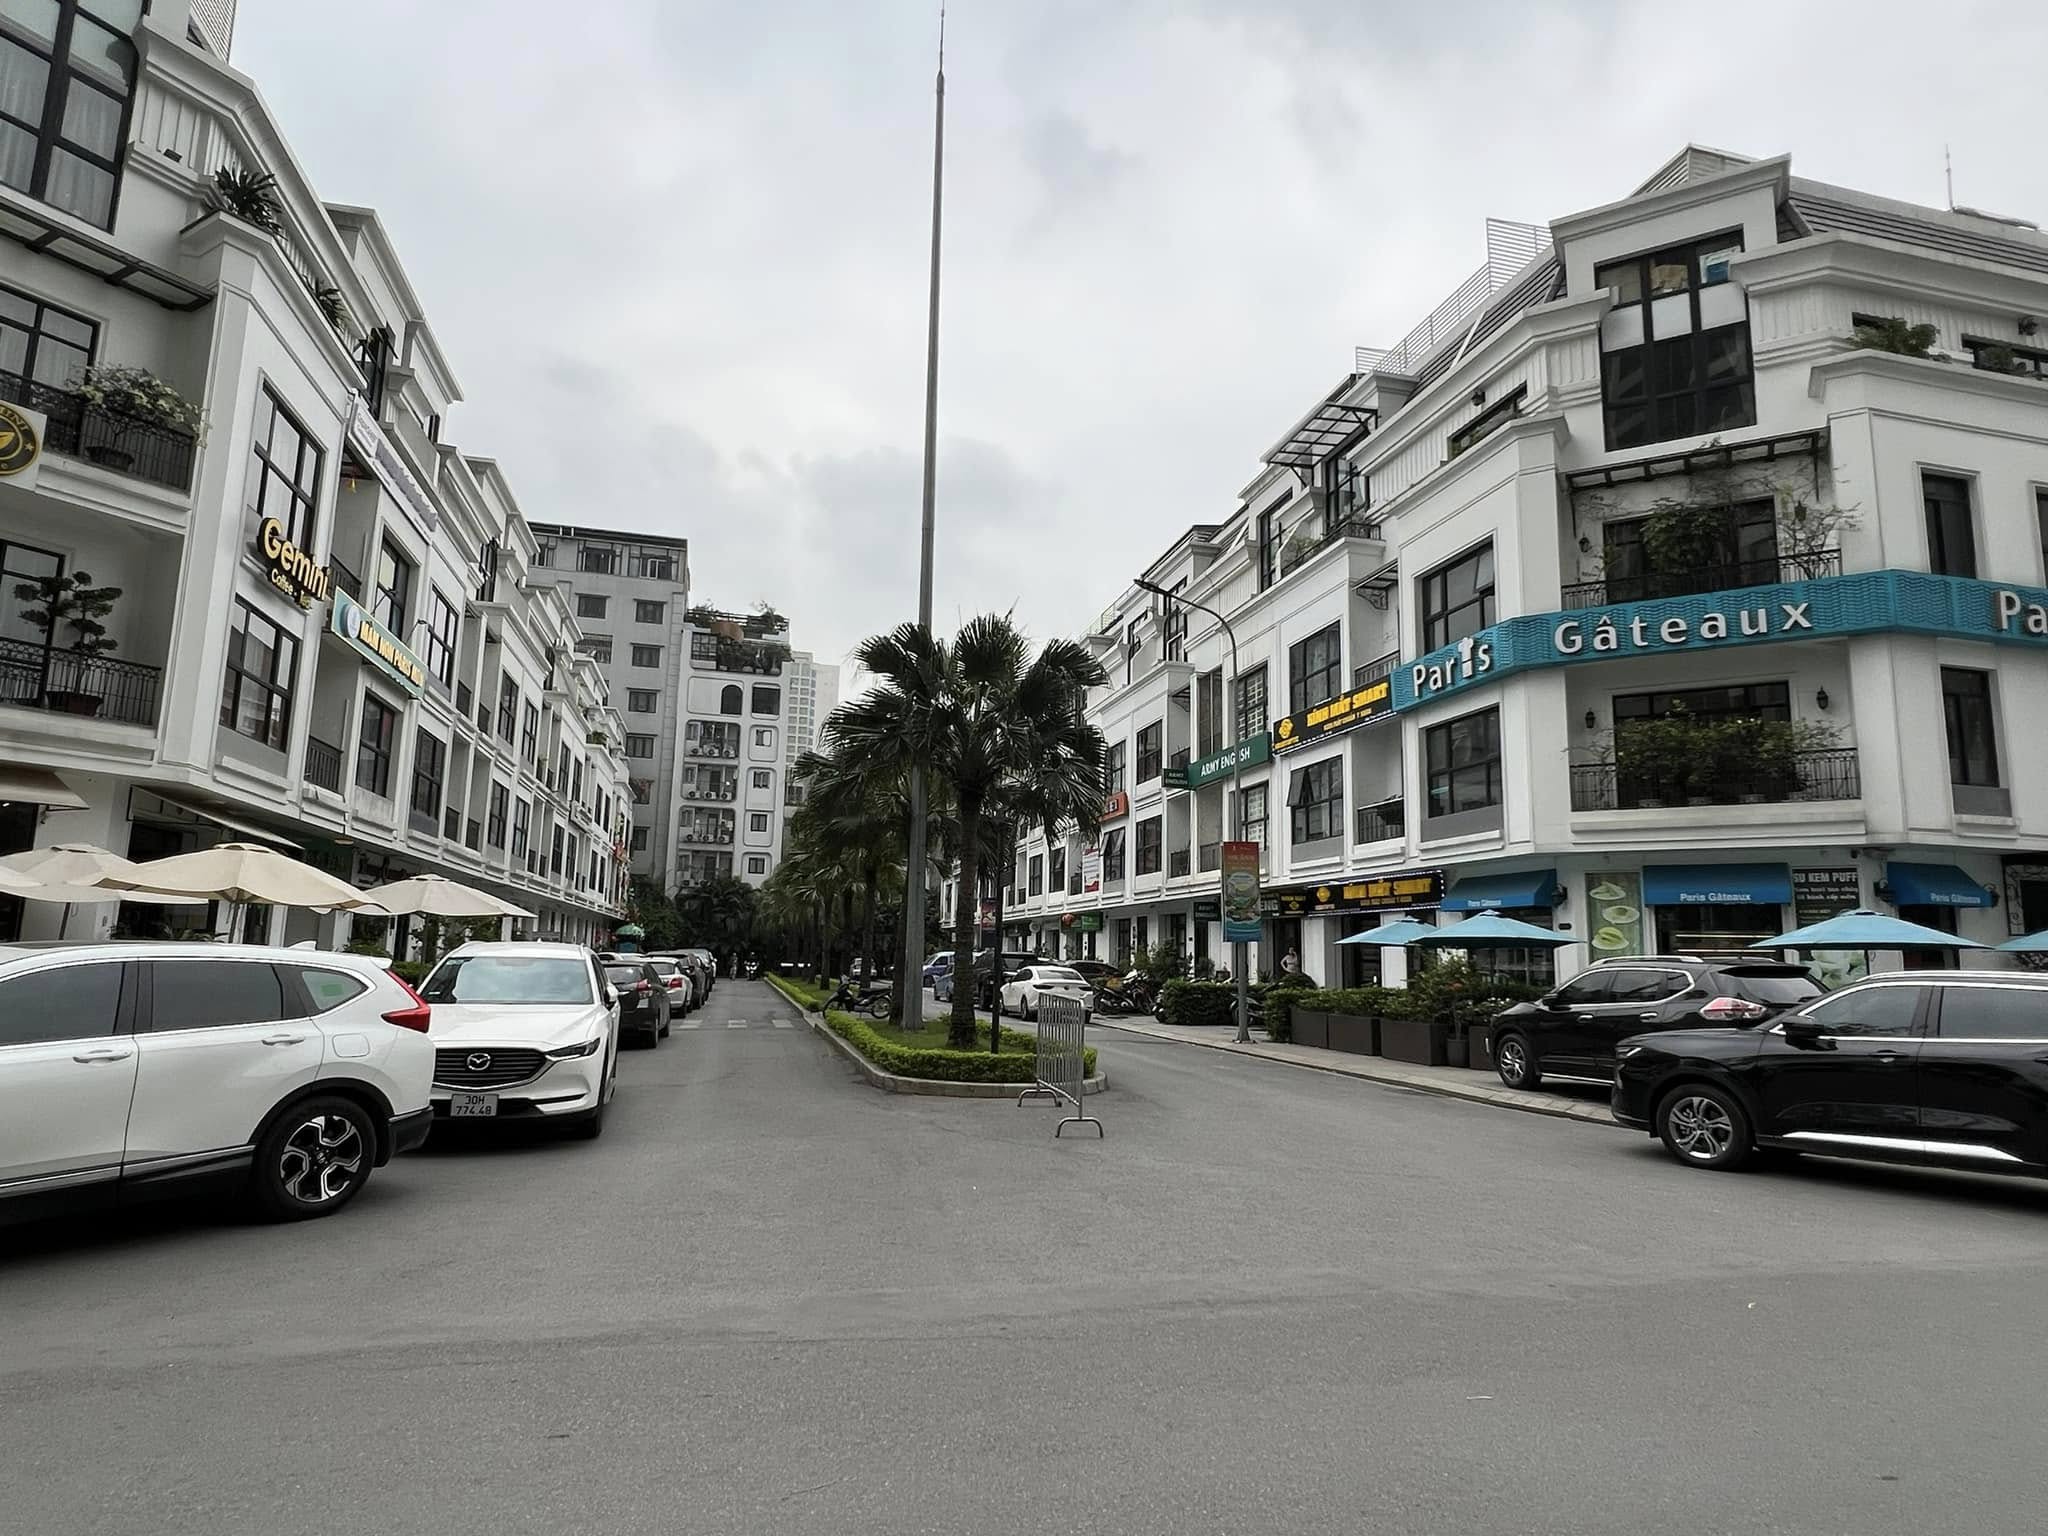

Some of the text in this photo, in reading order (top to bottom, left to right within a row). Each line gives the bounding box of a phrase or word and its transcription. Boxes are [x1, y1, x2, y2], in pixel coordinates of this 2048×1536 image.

[263, 518, 332, 600] Gemini
[271, 568, 295, 596] Coffee
[1412, 602, 1813, 697] Paris Gâteaux
[1201, 746, 1251, 777] ARMY ENGISH
[1680, 893, 1706, 902] Paris
[464, 1095, 486, 1105] 30H
